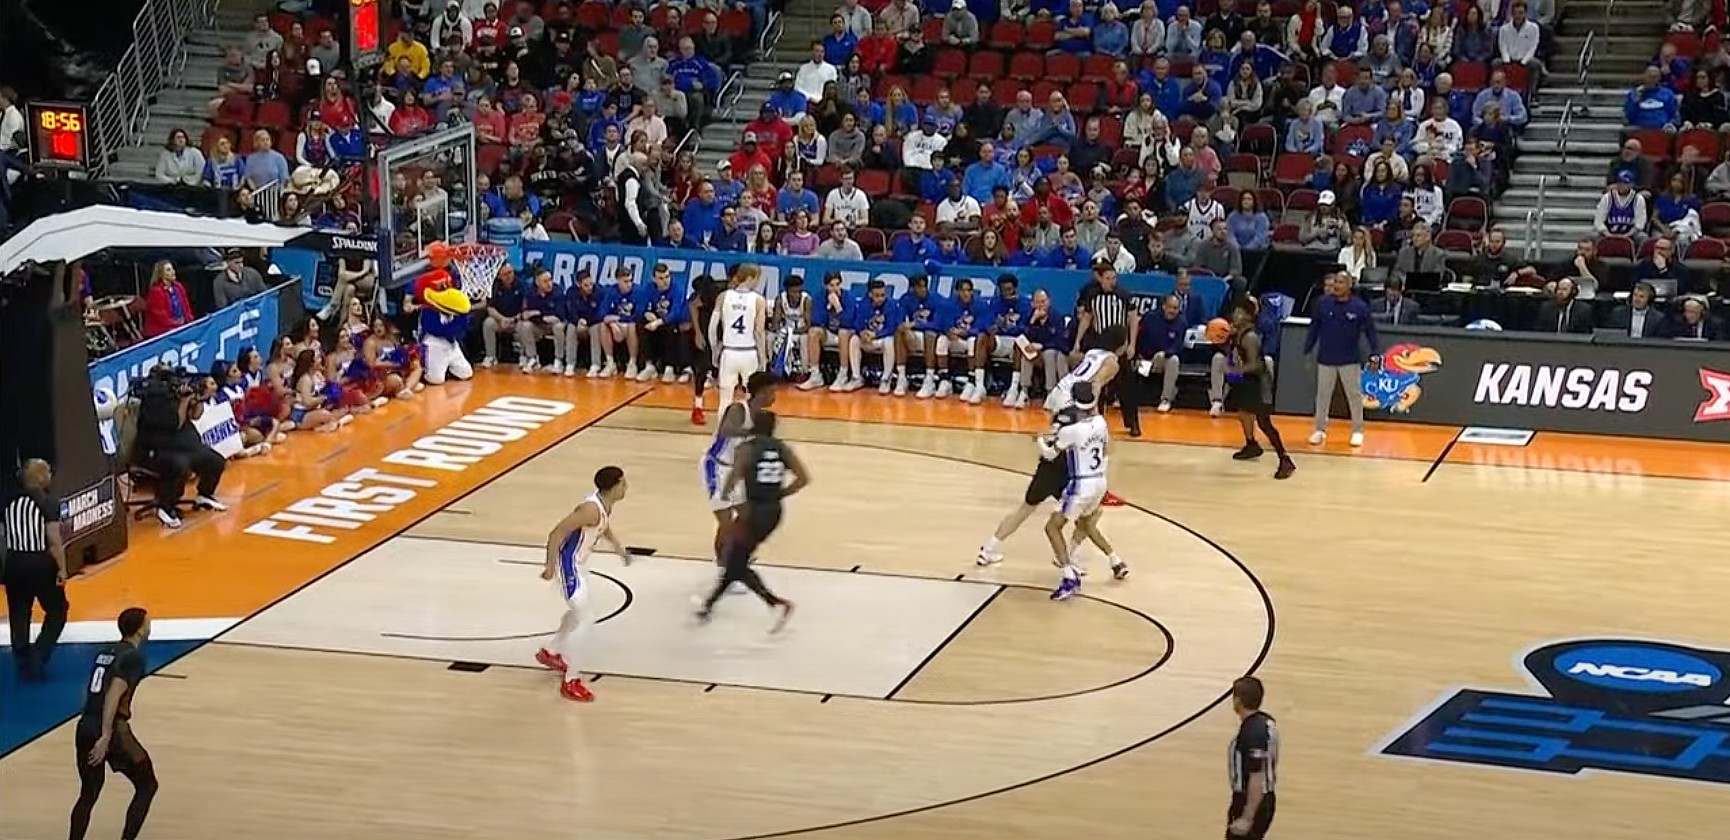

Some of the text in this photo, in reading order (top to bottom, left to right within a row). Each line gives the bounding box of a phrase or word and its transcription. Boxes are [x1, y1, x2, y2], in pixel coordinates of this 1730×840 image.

[41, 110, 81, 131] 18:56
[553, 253, 644, 295] ROAD
[731, 315, 746, 334] 4
[1378, 377, 1399, 393] KU
[1474, 363, 1653, 413] KANSAS
[243, 396, 575, 544] FIRST ROUND
[1090, 447, 1101, 470] 3
[68, 488, 98, 517] MARCH
[73, 500, 113, 532] MADNESS
[90, 666, 105, 693] 0
[1568, 662, 1711, 687] NCAA
